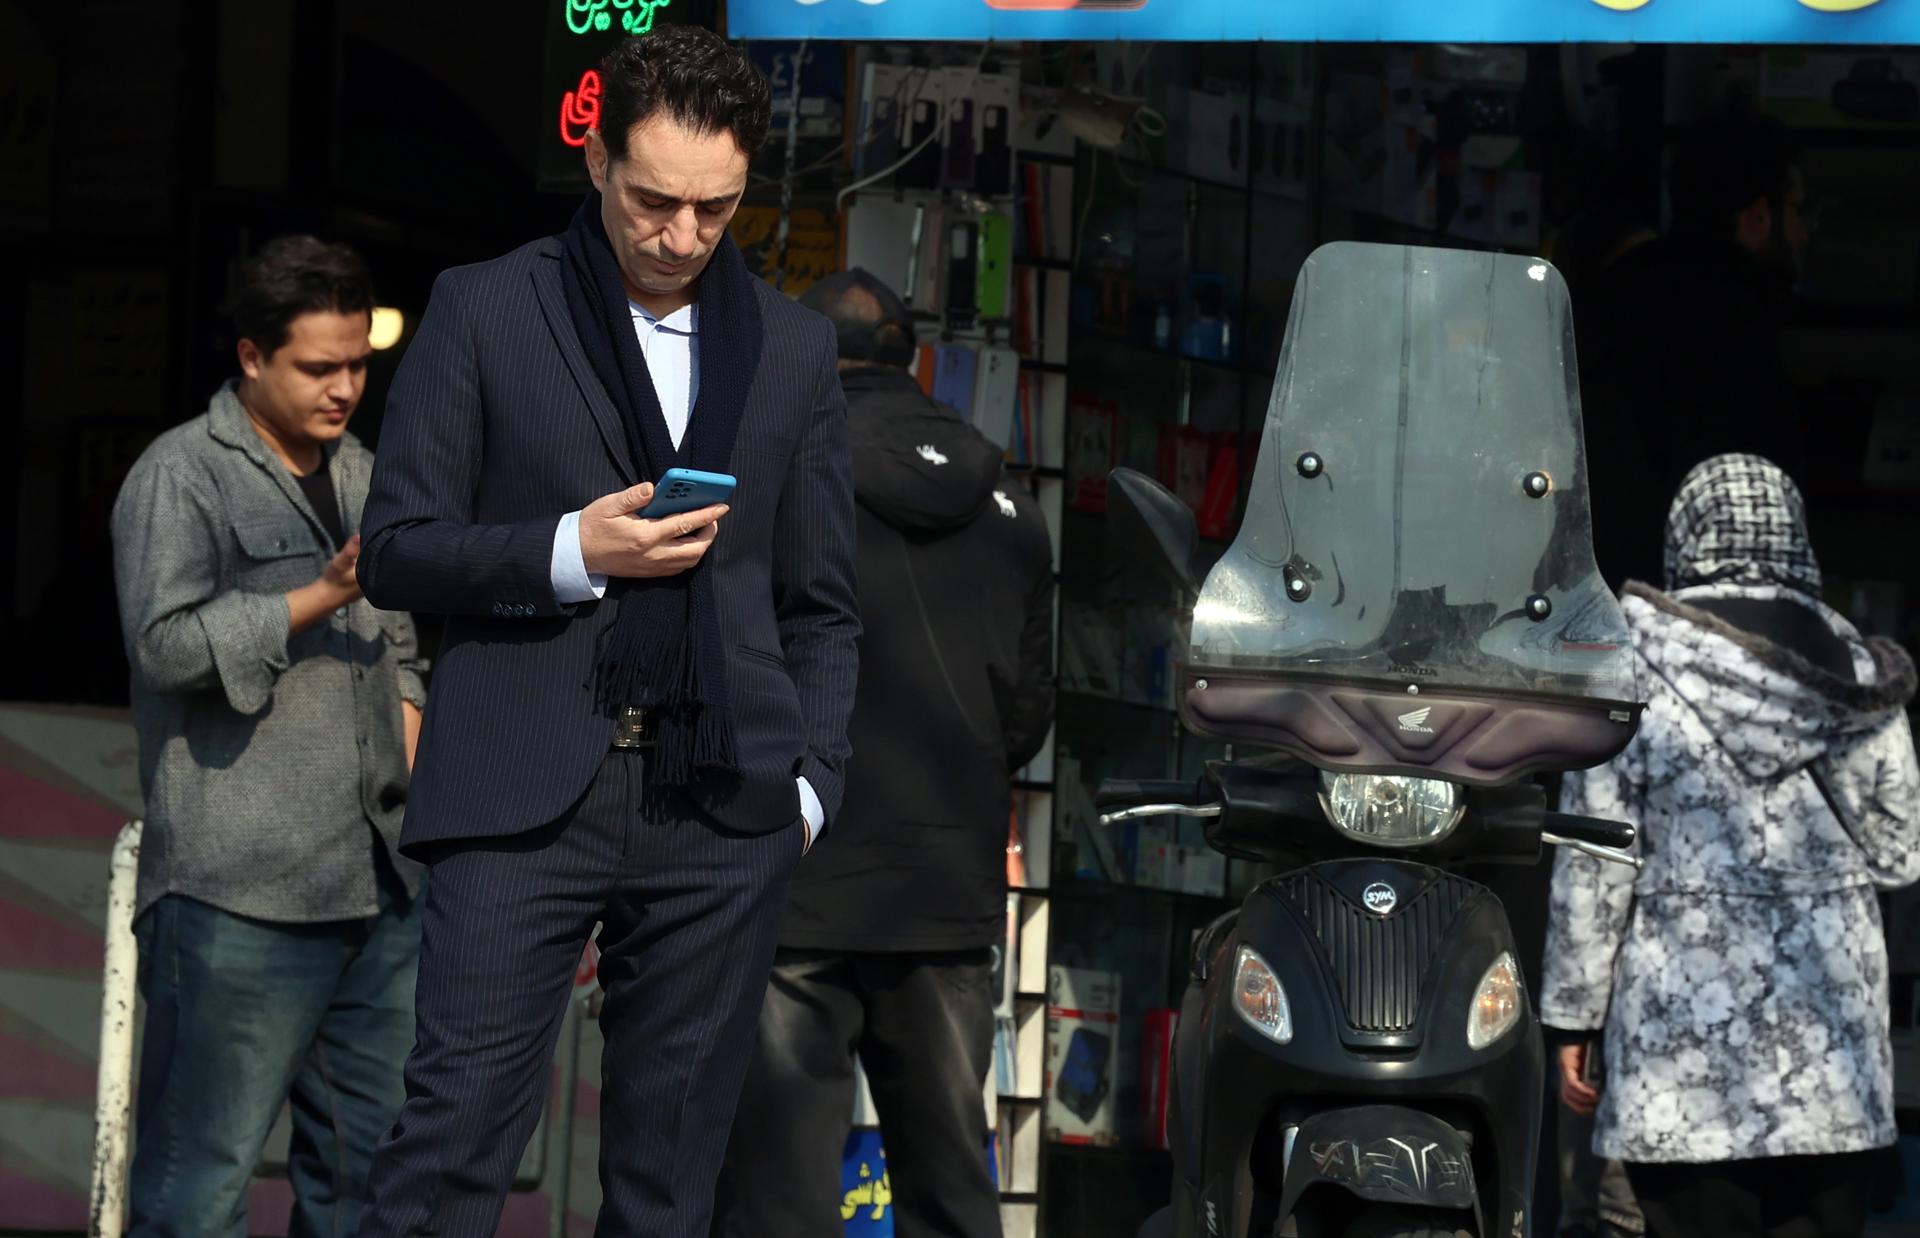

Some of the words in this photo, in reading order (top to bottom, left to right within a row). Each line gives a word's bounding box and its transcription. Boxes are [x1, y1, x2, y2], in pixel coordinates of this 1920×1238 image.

[1387, 664, 1438, 677] HONDA
[1399, 725, 1434, 734] HONDA
[1367, 891, 1395, 904] SYM
